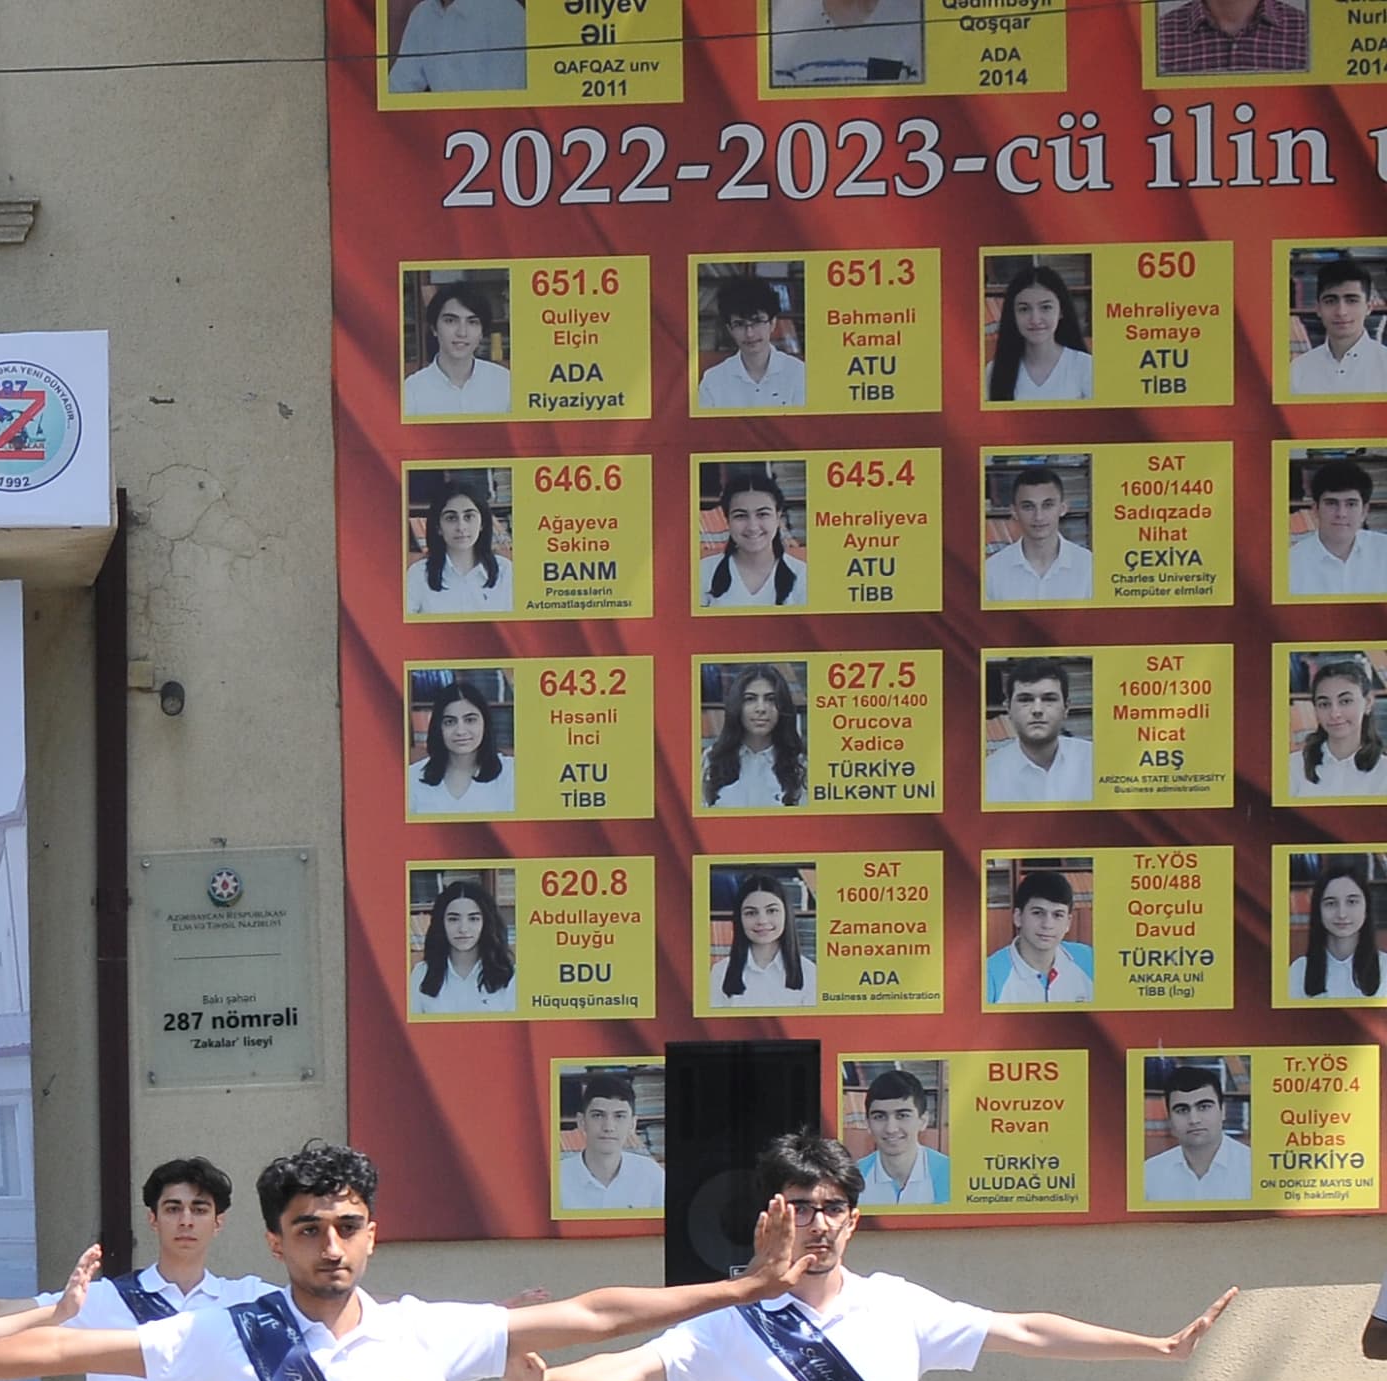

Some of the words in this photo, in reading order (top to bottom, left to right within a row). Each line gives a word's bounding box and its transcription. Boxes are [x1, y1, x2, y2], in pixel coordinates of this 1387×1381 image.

[580, 23, 617, 46] Əli
[553, 58, 626, 75] QAFQAZ
[629, 61, 660, 73] unv
[581, 79, 627, 98] 2011
[442, 112, 1114, 208] 2022-2023-cü
[1145, 102, 1336, 191] ilin
[531, 267, 620, 297] 651.6
[541, 308, 611, 328] Quliyev
[554, 329, 599, 349] Elçin
[549, 362, 604, 383] ADA
[528, 391, 625, 412] Riyaziyyat
[1147, 455, 1186, 472] SAT
[0, 477, 30, 487] 1992
[534, 464, 622, 493] 646.6
[1120, 479, 1214, 497] 1600/1440
[1114, 503, 1212, 524] Sadıqzadə
[537, 515, 618, 535] Ağayeva
[1138, 525, 1188, 542] Nihat
[546, 536, 610, 553] Səkinə
[1124, 546, 1203, 572] ÇEXİYA
[543, 560, 617, 582] BANM
[827, 661, 916, 690] 627.5
[815, 695, 848, 709] SAT
[852, 693, 928, 708] 1600/1400
[832, 714, 912, 730] Orucova
[840, 735, 905, 752] Xədicə
[827, 758, 916, 779] TÜRKİYƏ
[813, 782, 897, 801] BİLKƏNT
[903, 780, 935, 799] UNİ
[541, 868, 628, 897] 620.8
[528, 909, 641, 928] Abdullayeva
[556, 930, 615, 950] Duyğu
[559, 963, 611, 983] BDU
[164, 1012, 203, 1031] 287
[212, 1007, 298, 1030] nömrəli
[243, 1035, 273, 1049] liseyi
[988, 1061, 1059, 1082] BURS
[1282, 1053, 1348, 1073] Tr.YÖS
[1272, 1077, 1358, 1094] 500/470.4
[975, 1096, 1065, 1112] Novruzov
[991, 1118, 1049, 1134] Rəvan
[1280, 1109, 1352, 1127] Quliyev
[1285, 1131, 1346, 1147] Abbas
